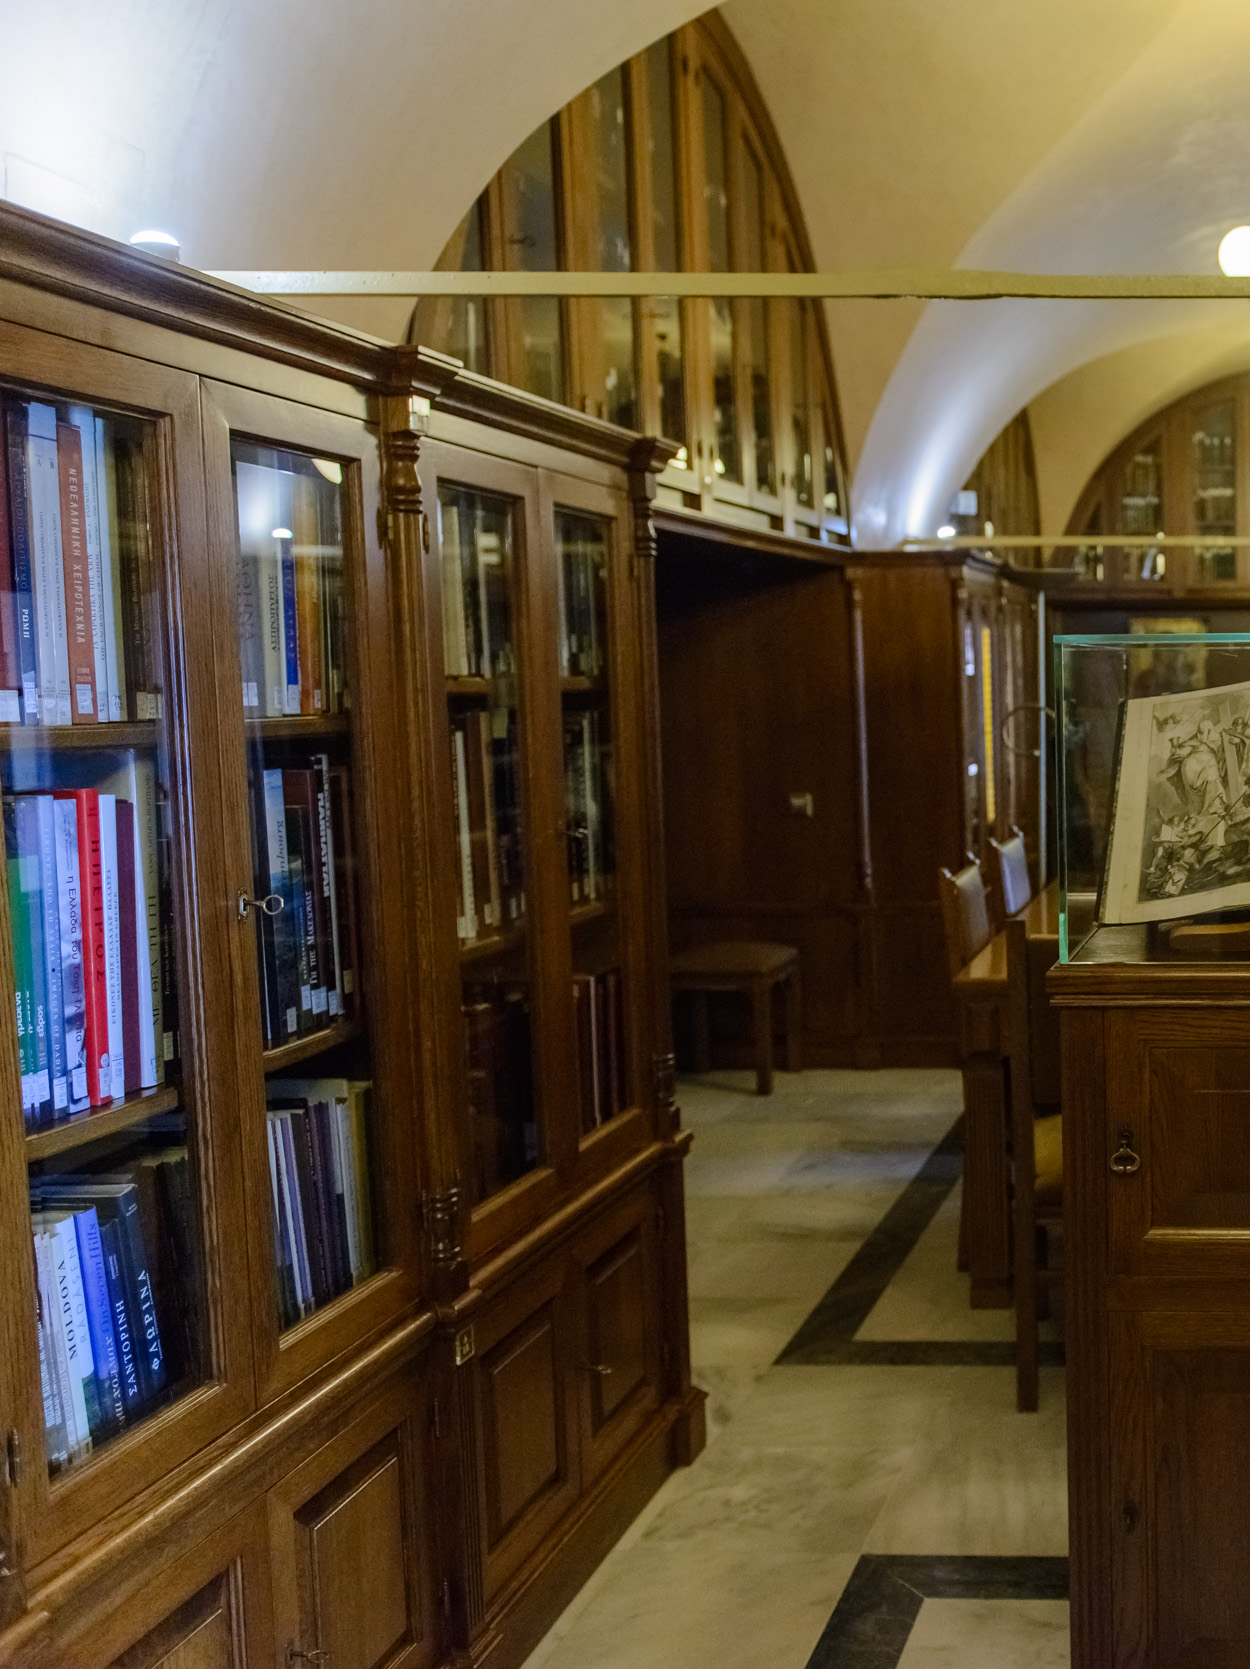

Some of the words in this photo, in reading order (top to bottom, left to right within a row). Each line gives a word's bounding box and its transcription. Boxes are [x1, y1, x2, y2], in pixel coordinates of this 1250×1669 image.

[68, 468, 82, 557] ΝΕΟΕΛΛΗΝΙΚΗ
[22, 608, 30, 639] ΡΩΜΗ
[72, 564, 87, 644] ΧΕΙΡΟΤΕΧΝΙΑ
[268, 573, 277, 651] ΑΣΠΡΟΠΥΡΓΟΣ
[66, 875, 74, 884] η
[68, 887, 78, 935] Ελλάδα
[71, 937, 81, 960] του
[51, 979, 59, 1020] IMAGES
[54, 1025, 60, 1038] OF
[87, 1222, 101, 1260] Hills
[57, 1260, 78, 1360] MOLDOVA
[95, 1262, 110, 1312] Seven
[100, 1314, 110, 1334] On
[137, 1269, 160, 1371] ΦΛΩΡΙΝΑ
[115, 1299, 138, 1397] ΣΑΝΤΟΡΙΝΗ
